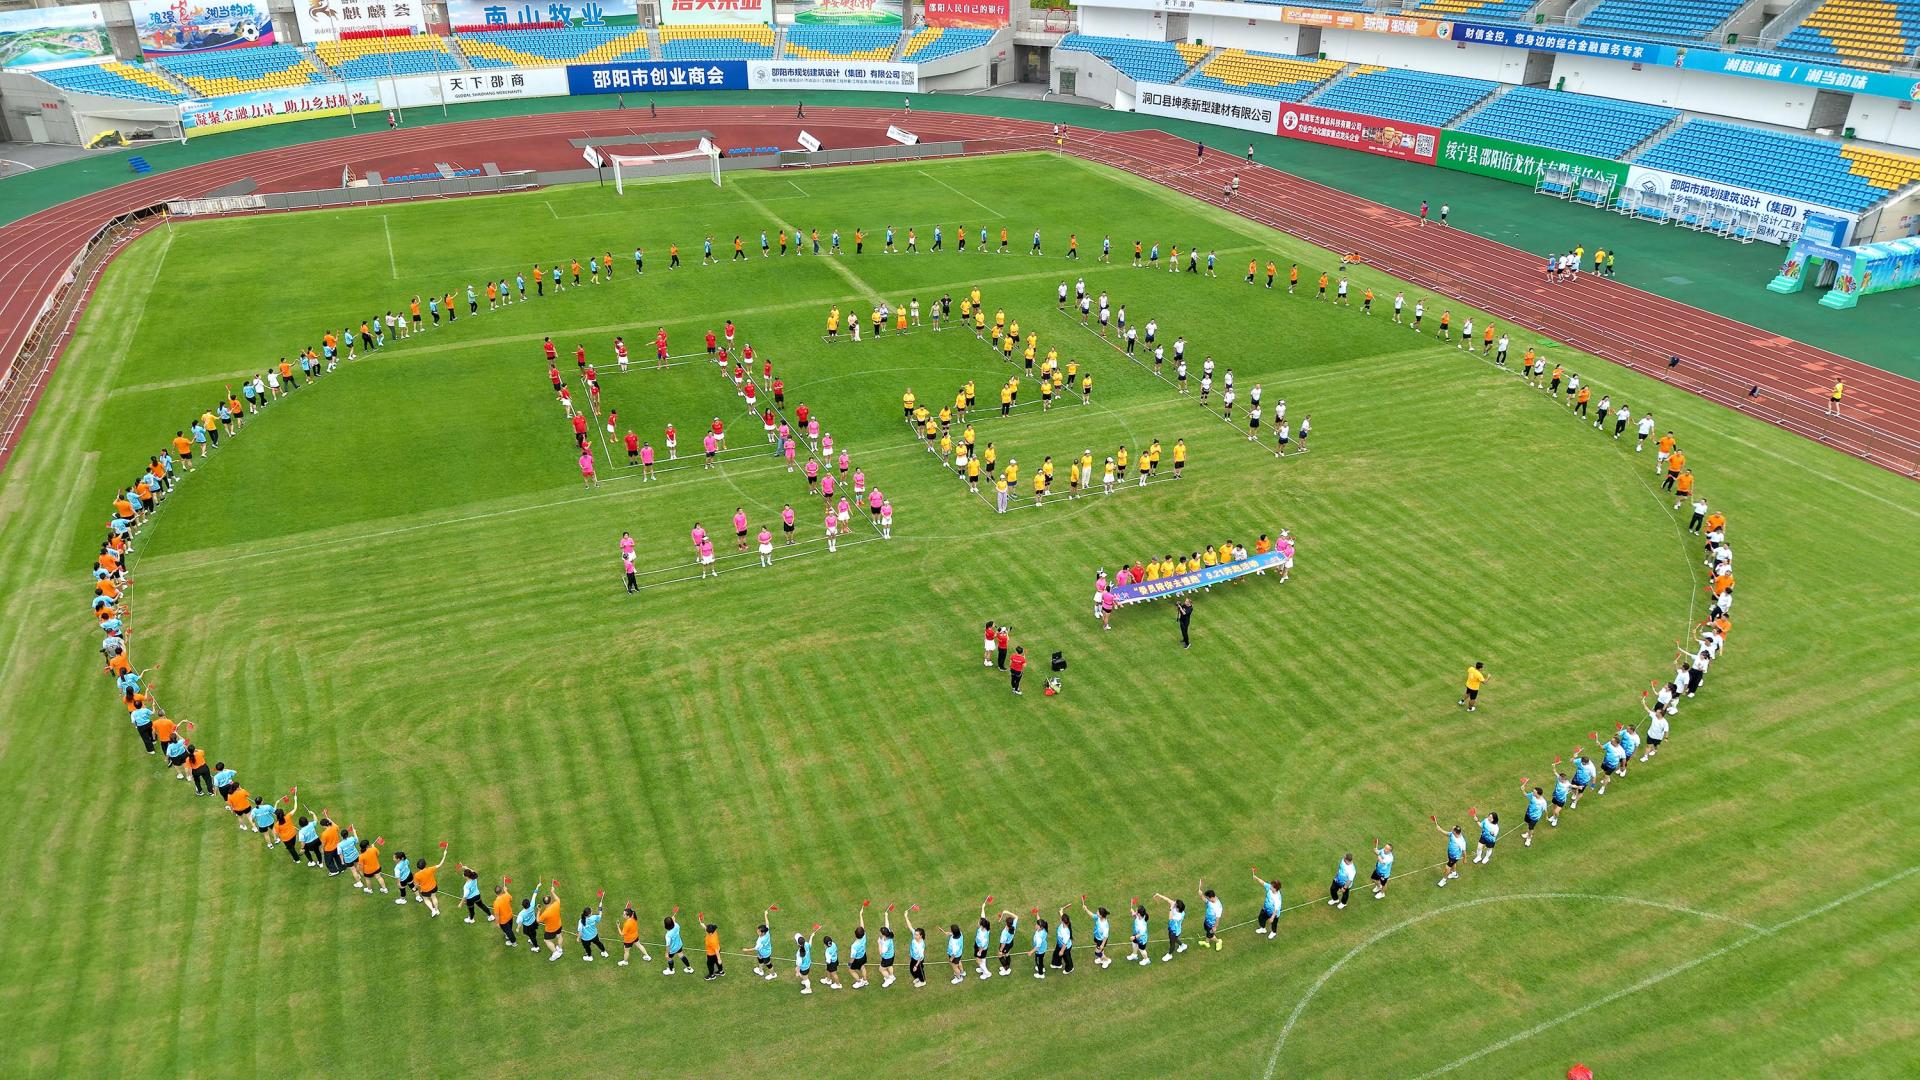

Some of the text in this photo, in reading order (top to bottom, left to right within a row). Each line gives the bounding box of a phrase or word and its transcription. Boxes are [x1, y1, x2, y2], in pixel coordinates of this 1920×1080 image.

[484, 2, 606, 27] 南山牧业
[928, 3, 1005, 15] 邵阳人民自己的银行
[450, 73, 525, 91] 天下邵商
[592, 65, 724, 89] 邵阳市创业商会
[1804, 68, 1869, 90] 湘当韵味
[193, 92, 367, 127] 凝聚金融力量 助力乡村振兴
[1142, 91, 1272, 123] 洞口县坤泰新型建材有限公司
[1445, 140, 1478, 163] 绥宁县
